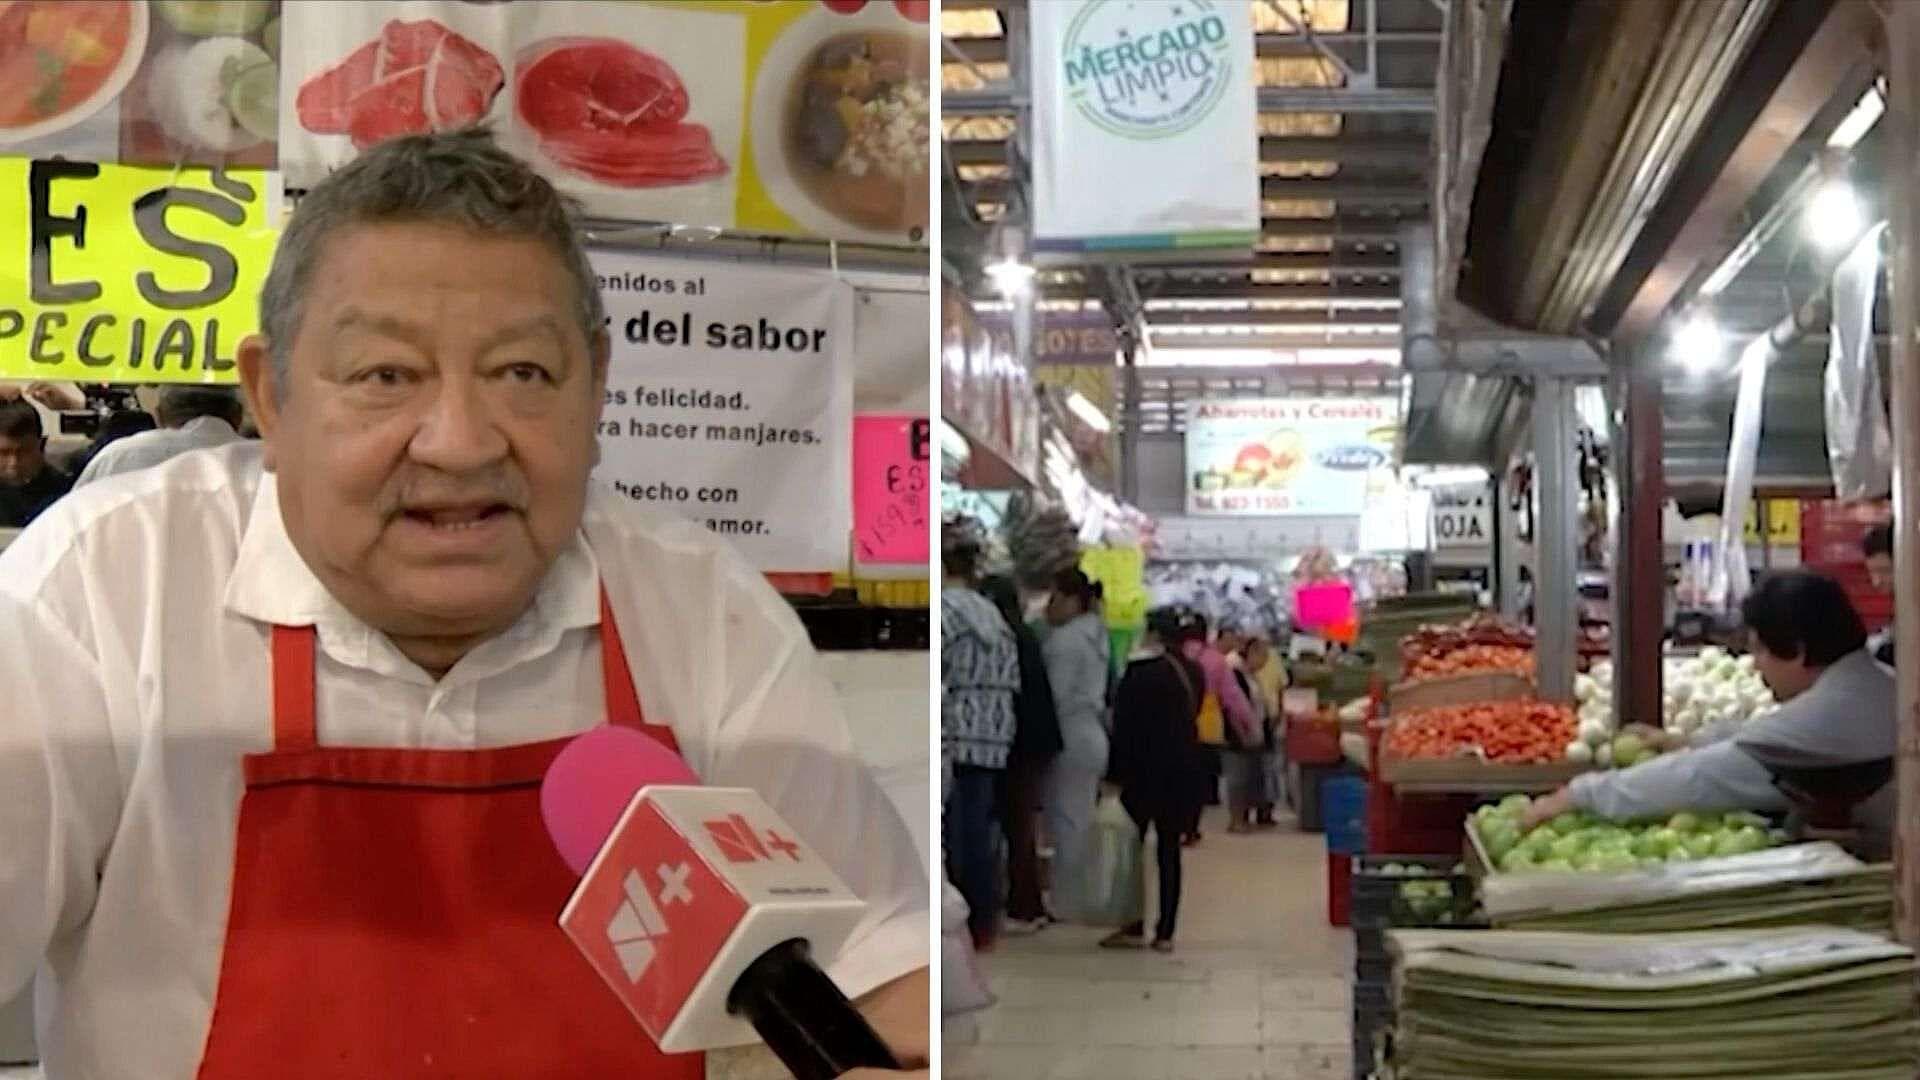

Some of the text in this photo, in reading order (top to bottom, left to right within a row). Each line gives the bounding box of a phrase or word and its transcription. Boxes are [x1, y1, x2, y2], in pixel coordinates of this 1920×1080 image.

[1064, 16, 1225, 86] MERCADO
[1097, 48, 1214, 103] LIMPIO
[684, 277, 705, 296] al
[626, 310, 827, 353] del sabor
[635, 386, 751, 411] felicidad.
[629, 417, 699, 440] hacer
[706, 423, 822, 447] manjares.
[697, 487, 739, 503] con
[706, 517, 771, 535] amor.
